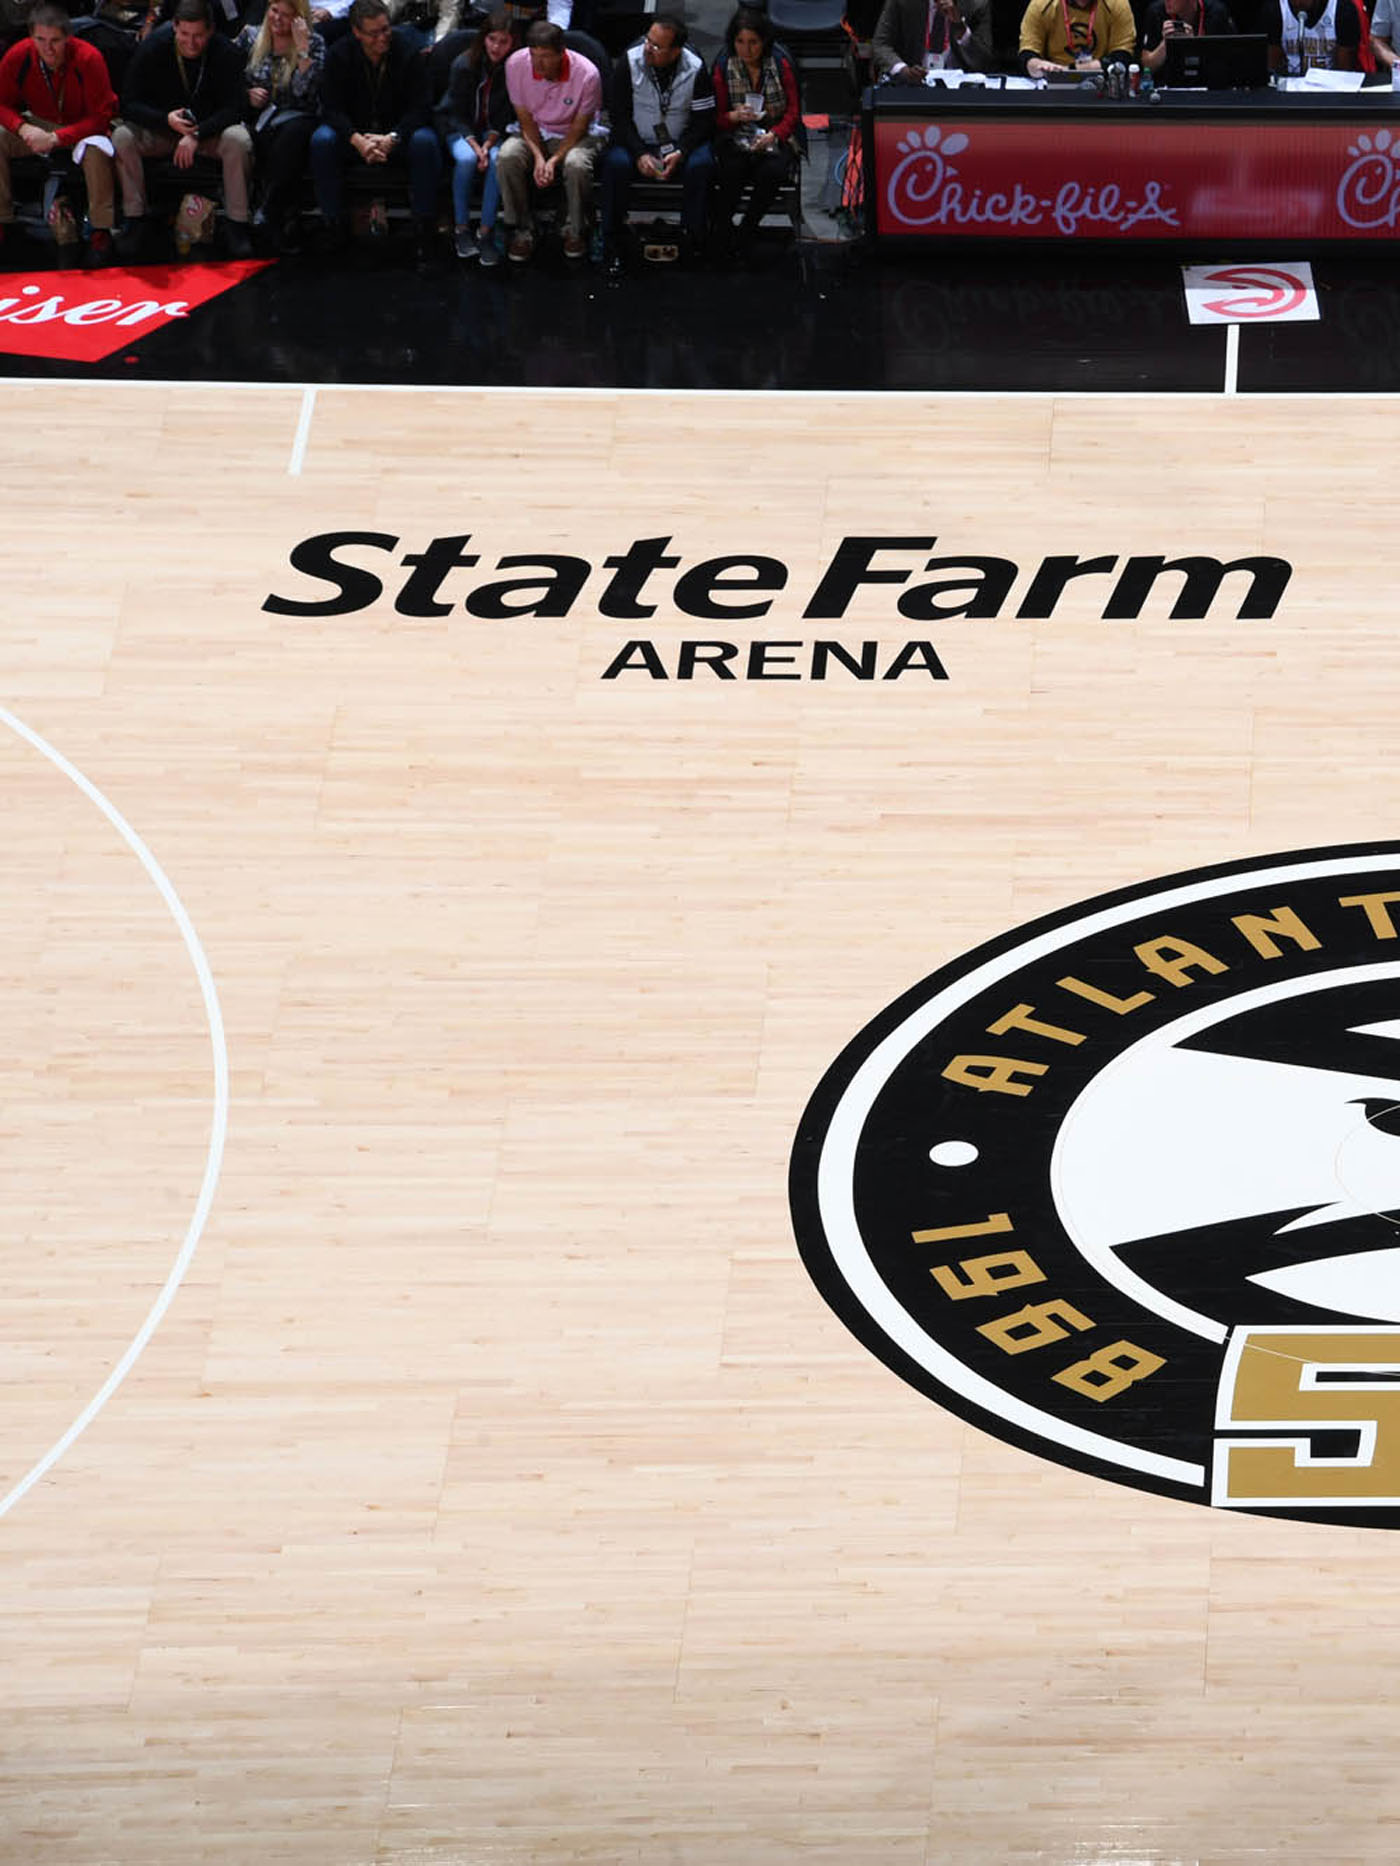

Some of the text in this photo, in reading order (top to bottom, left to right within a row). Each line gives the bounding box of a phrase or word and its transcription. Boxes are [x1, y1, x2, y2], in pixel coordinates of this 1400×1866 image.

[888, 150, 1180, 234] Chick-fil-A
[600, 640, 950, 681] ARENA
[911, 1212, 1168, 1403] 1968
